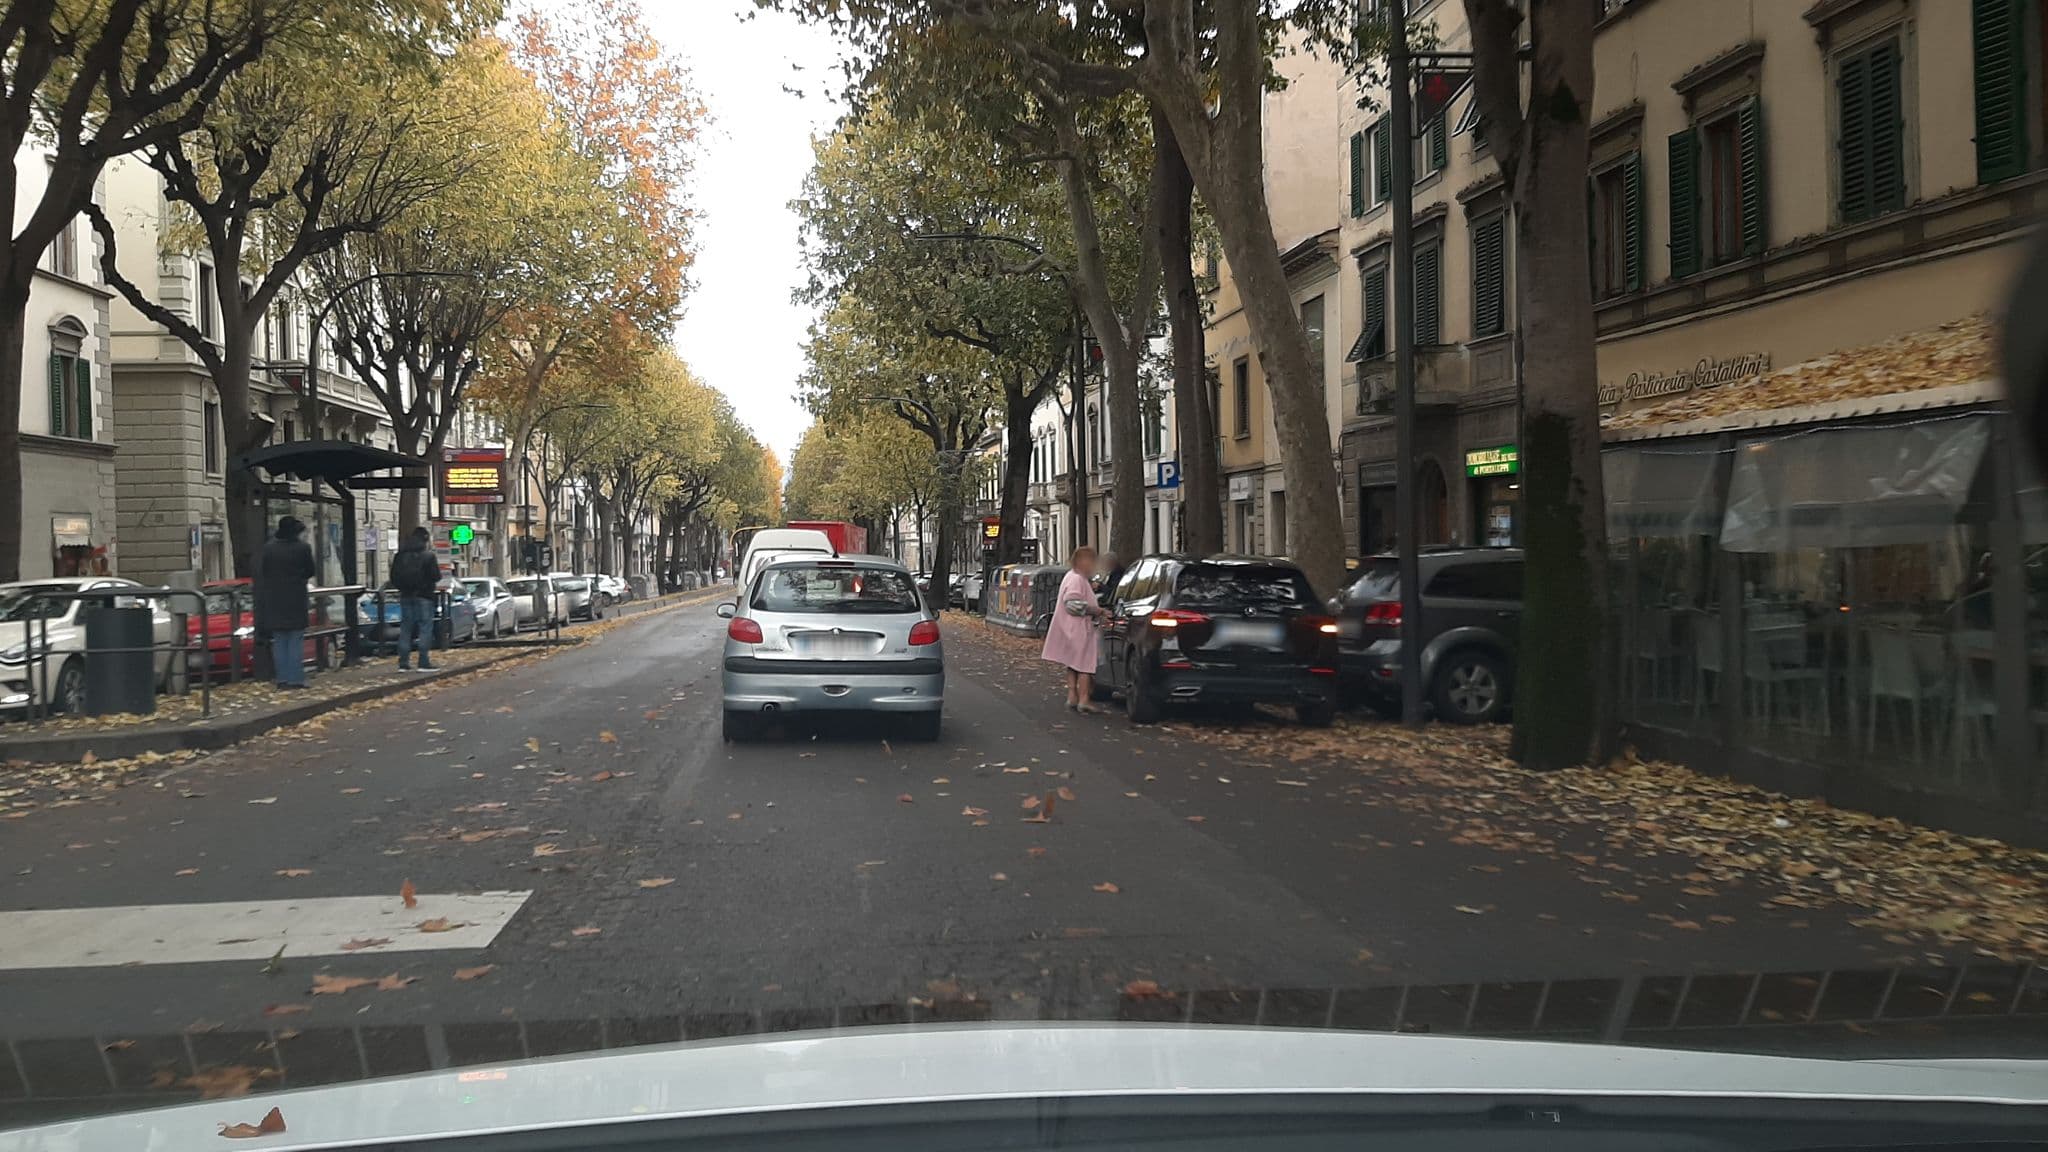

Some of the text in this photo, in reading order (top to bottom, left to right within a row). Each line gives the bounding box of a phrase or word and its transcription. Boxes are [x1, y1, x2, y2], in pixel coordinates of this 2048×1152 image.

[1598, 354, 1762, 403] tica Pasticceria Castaldini
[1162, 464, 1175, 486] P
